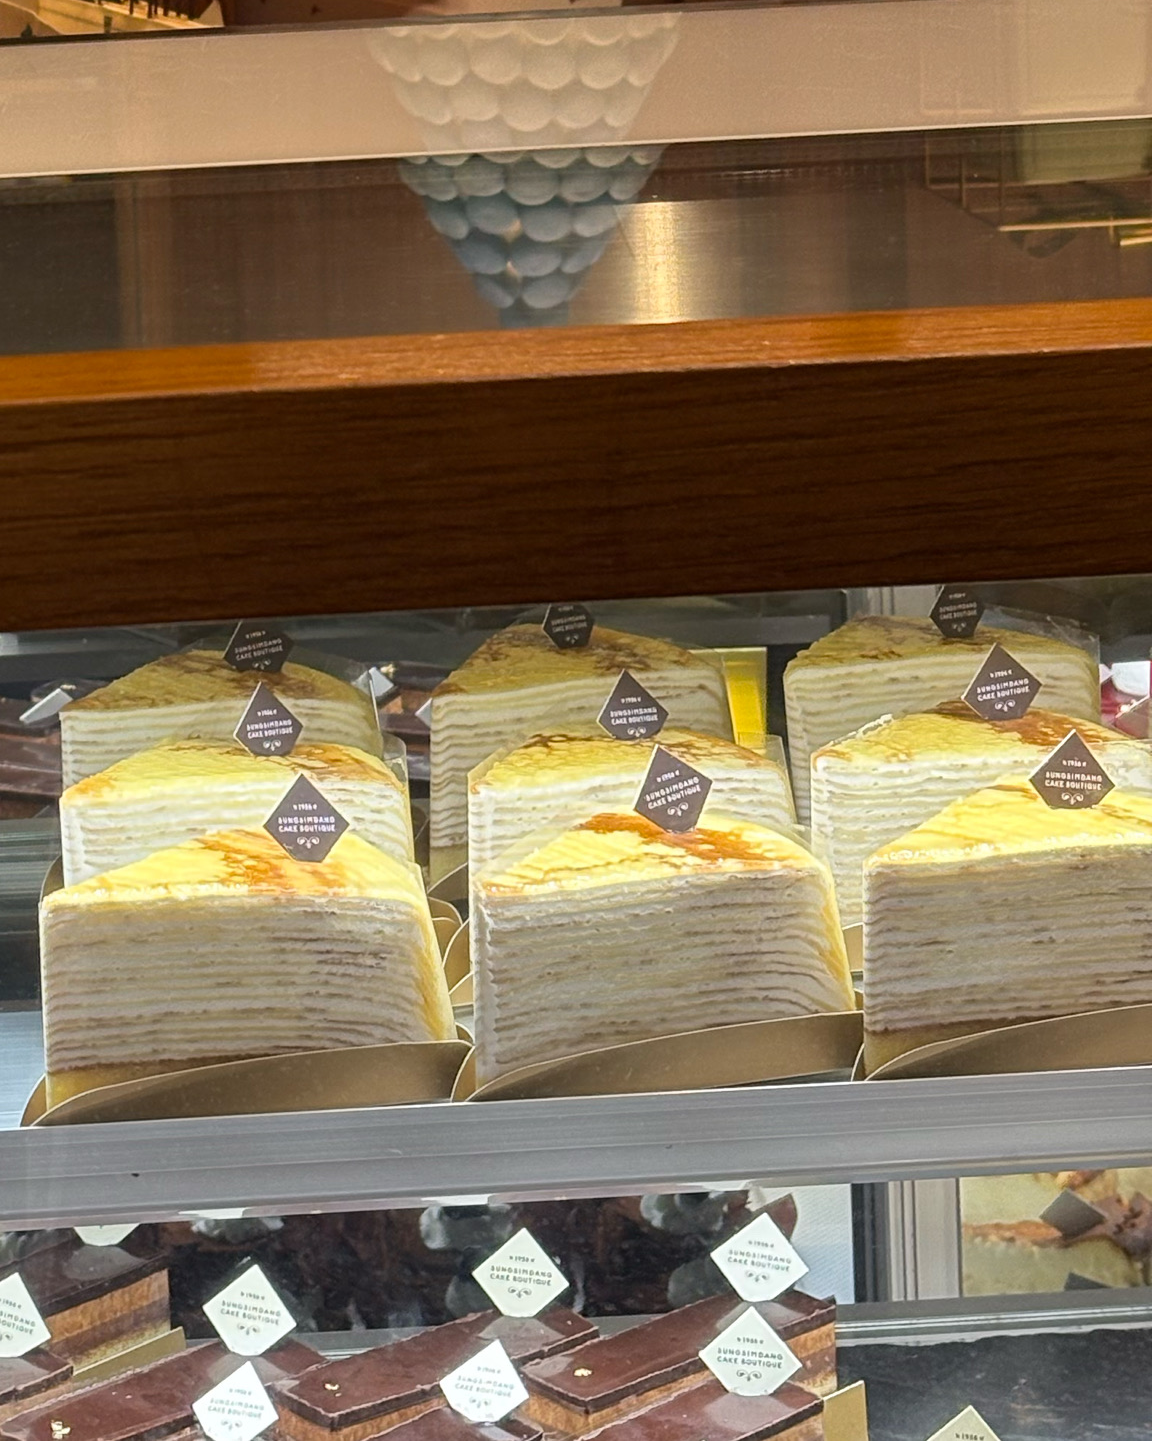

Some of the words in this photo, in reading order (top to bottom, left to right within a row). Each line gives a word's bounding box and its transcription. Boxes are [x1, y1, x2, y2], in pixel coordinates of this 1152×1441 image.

[977, 692, 996, 701] CAKE
[997, 686, 1030, 698] BOUTIQUE
[1044, 780, 1064, 788] CAKE
[1066, 781, 1102, 791] BOUTIQUE
[648, 797, 667, 810] CAKE
[667, 784, 701, 802] BOUTIQUE
[278, 825, 298, 833] CAKE
[299, 824, 336, 832] BOUTIQUE
[728, 1256, 748, 1265] CAKE
[751, 1260, 790, 1272] BOUTIQUE
[490, 1273, 510, 1281] CAKE
[513, 1276, 551, 1286] BOUTIQUE
[220, 1308, 239, 1317] CAKE
[242, 1312, 280, 1326] BOUTIQUE
[717, 1356, 738, 1364] CAKE
[741, 1358, 782, 1369] BOUTIQUE
